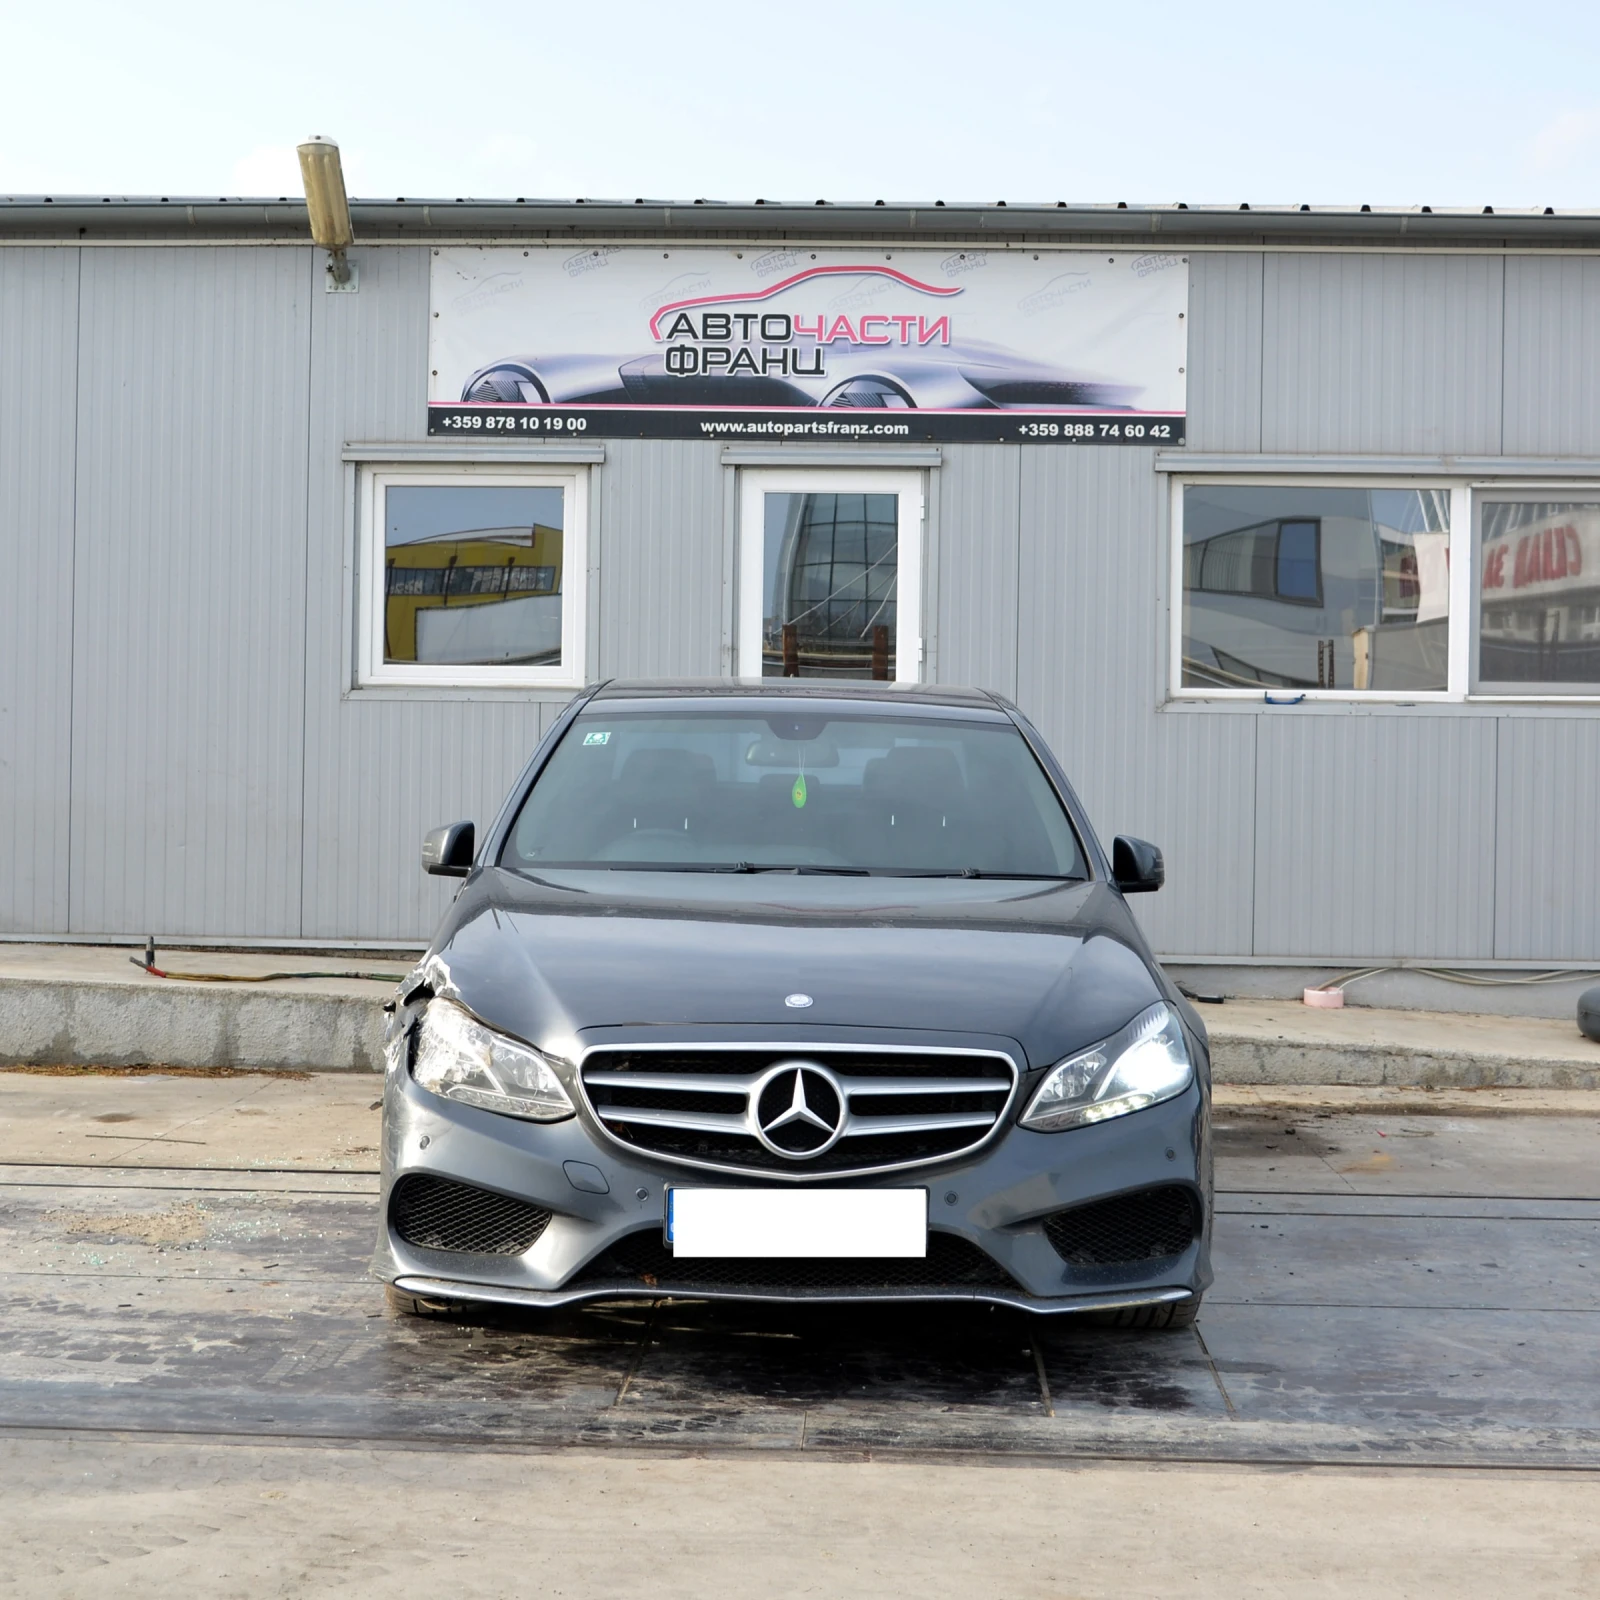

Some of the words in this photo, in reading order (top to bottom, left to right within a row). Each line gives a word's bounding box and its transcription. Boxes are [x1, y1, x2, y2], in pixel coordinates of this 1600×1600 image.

[569, 258, 609, 277] ФРАНЦ
[757, 258, 798, 278] ФРАНЦ
[947, 258, 987, 278] ФРАНЦ
[1137, 258, 1178, 278] ФРАНЦ
[666, 313, 949, 343] АВТОЧАСТИ
[665, 344, 825, 375] ФРАНЦ
[442, 416, 482, 429] +359
[485, 416, 515, 430] 878
[519, 417, 540, 430] 10
[543, 417, 563, 430] 19
[566, 418, 587, 431] 00
[700, 421, 909, 436] www.autopartsfranz.com
[1018, 423, 1059, 437] +359
[1063, 424, 1094, 437] 888
[1099, 424, 1120, 437] 74
[1124, 425, 1145, 438] 60
[1149, 425, 1170, 438] 42
